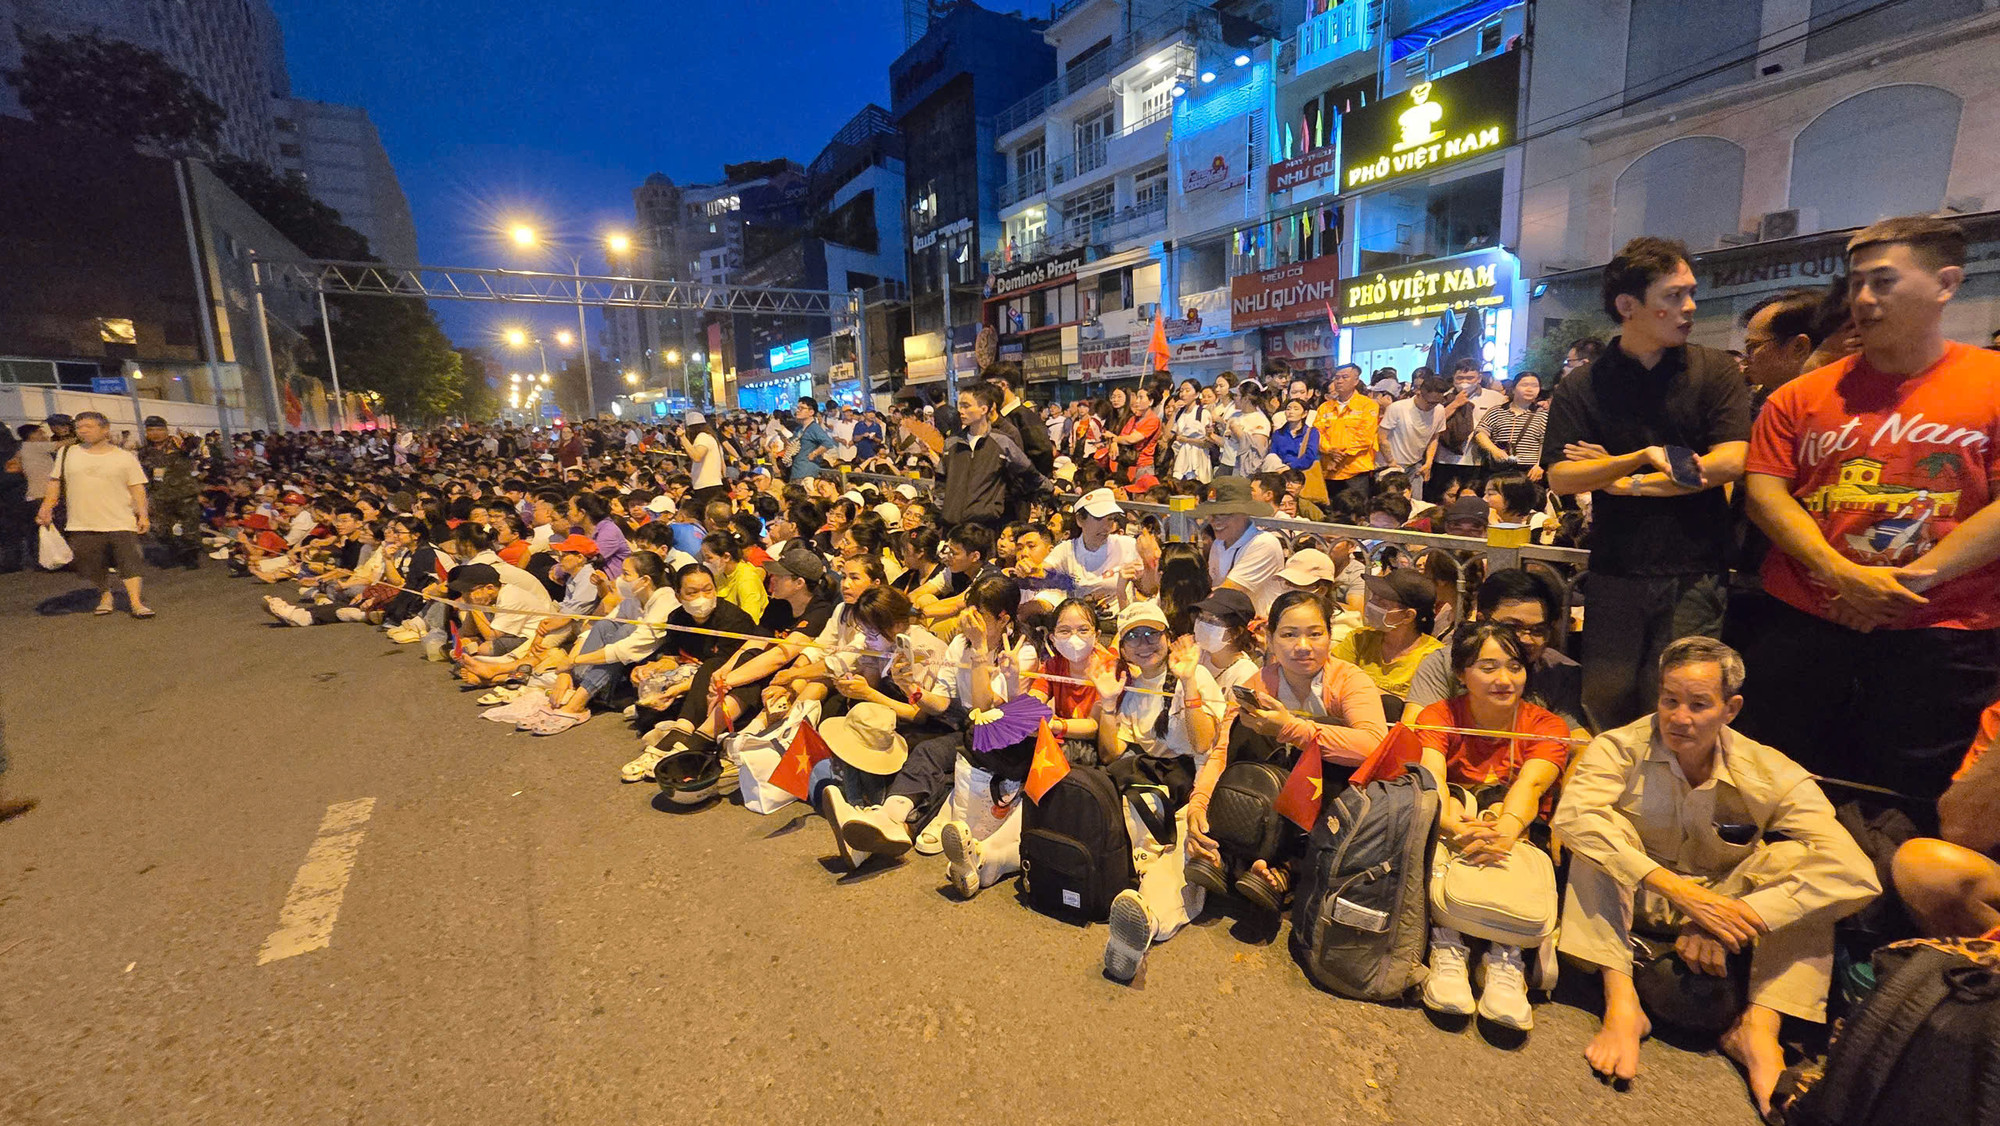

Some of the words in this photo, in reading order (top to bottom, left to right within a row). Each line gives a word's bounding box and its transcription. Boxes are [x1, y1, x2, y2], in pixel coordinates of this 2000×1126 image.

[1392, 143, 1441, 172] VIỆT
[1444, 126, 1500, 159] NAM
[1277, 165, 1310, 187] NHƯ
[996, 265, 1045, 294] Domino's
[1047, 257, 1080, 279] Pizza
[1349, 273, 1388, 308] PHỞ
[1389, 269, 1440, 304] VIỆT
[1442, 263, 1498, 293] NAM
[1233, 288, 1270, 315] NHƯ
[1271, 279, 1335, 312] QUỲNH
[1268, 335, 1283, 352] 16
